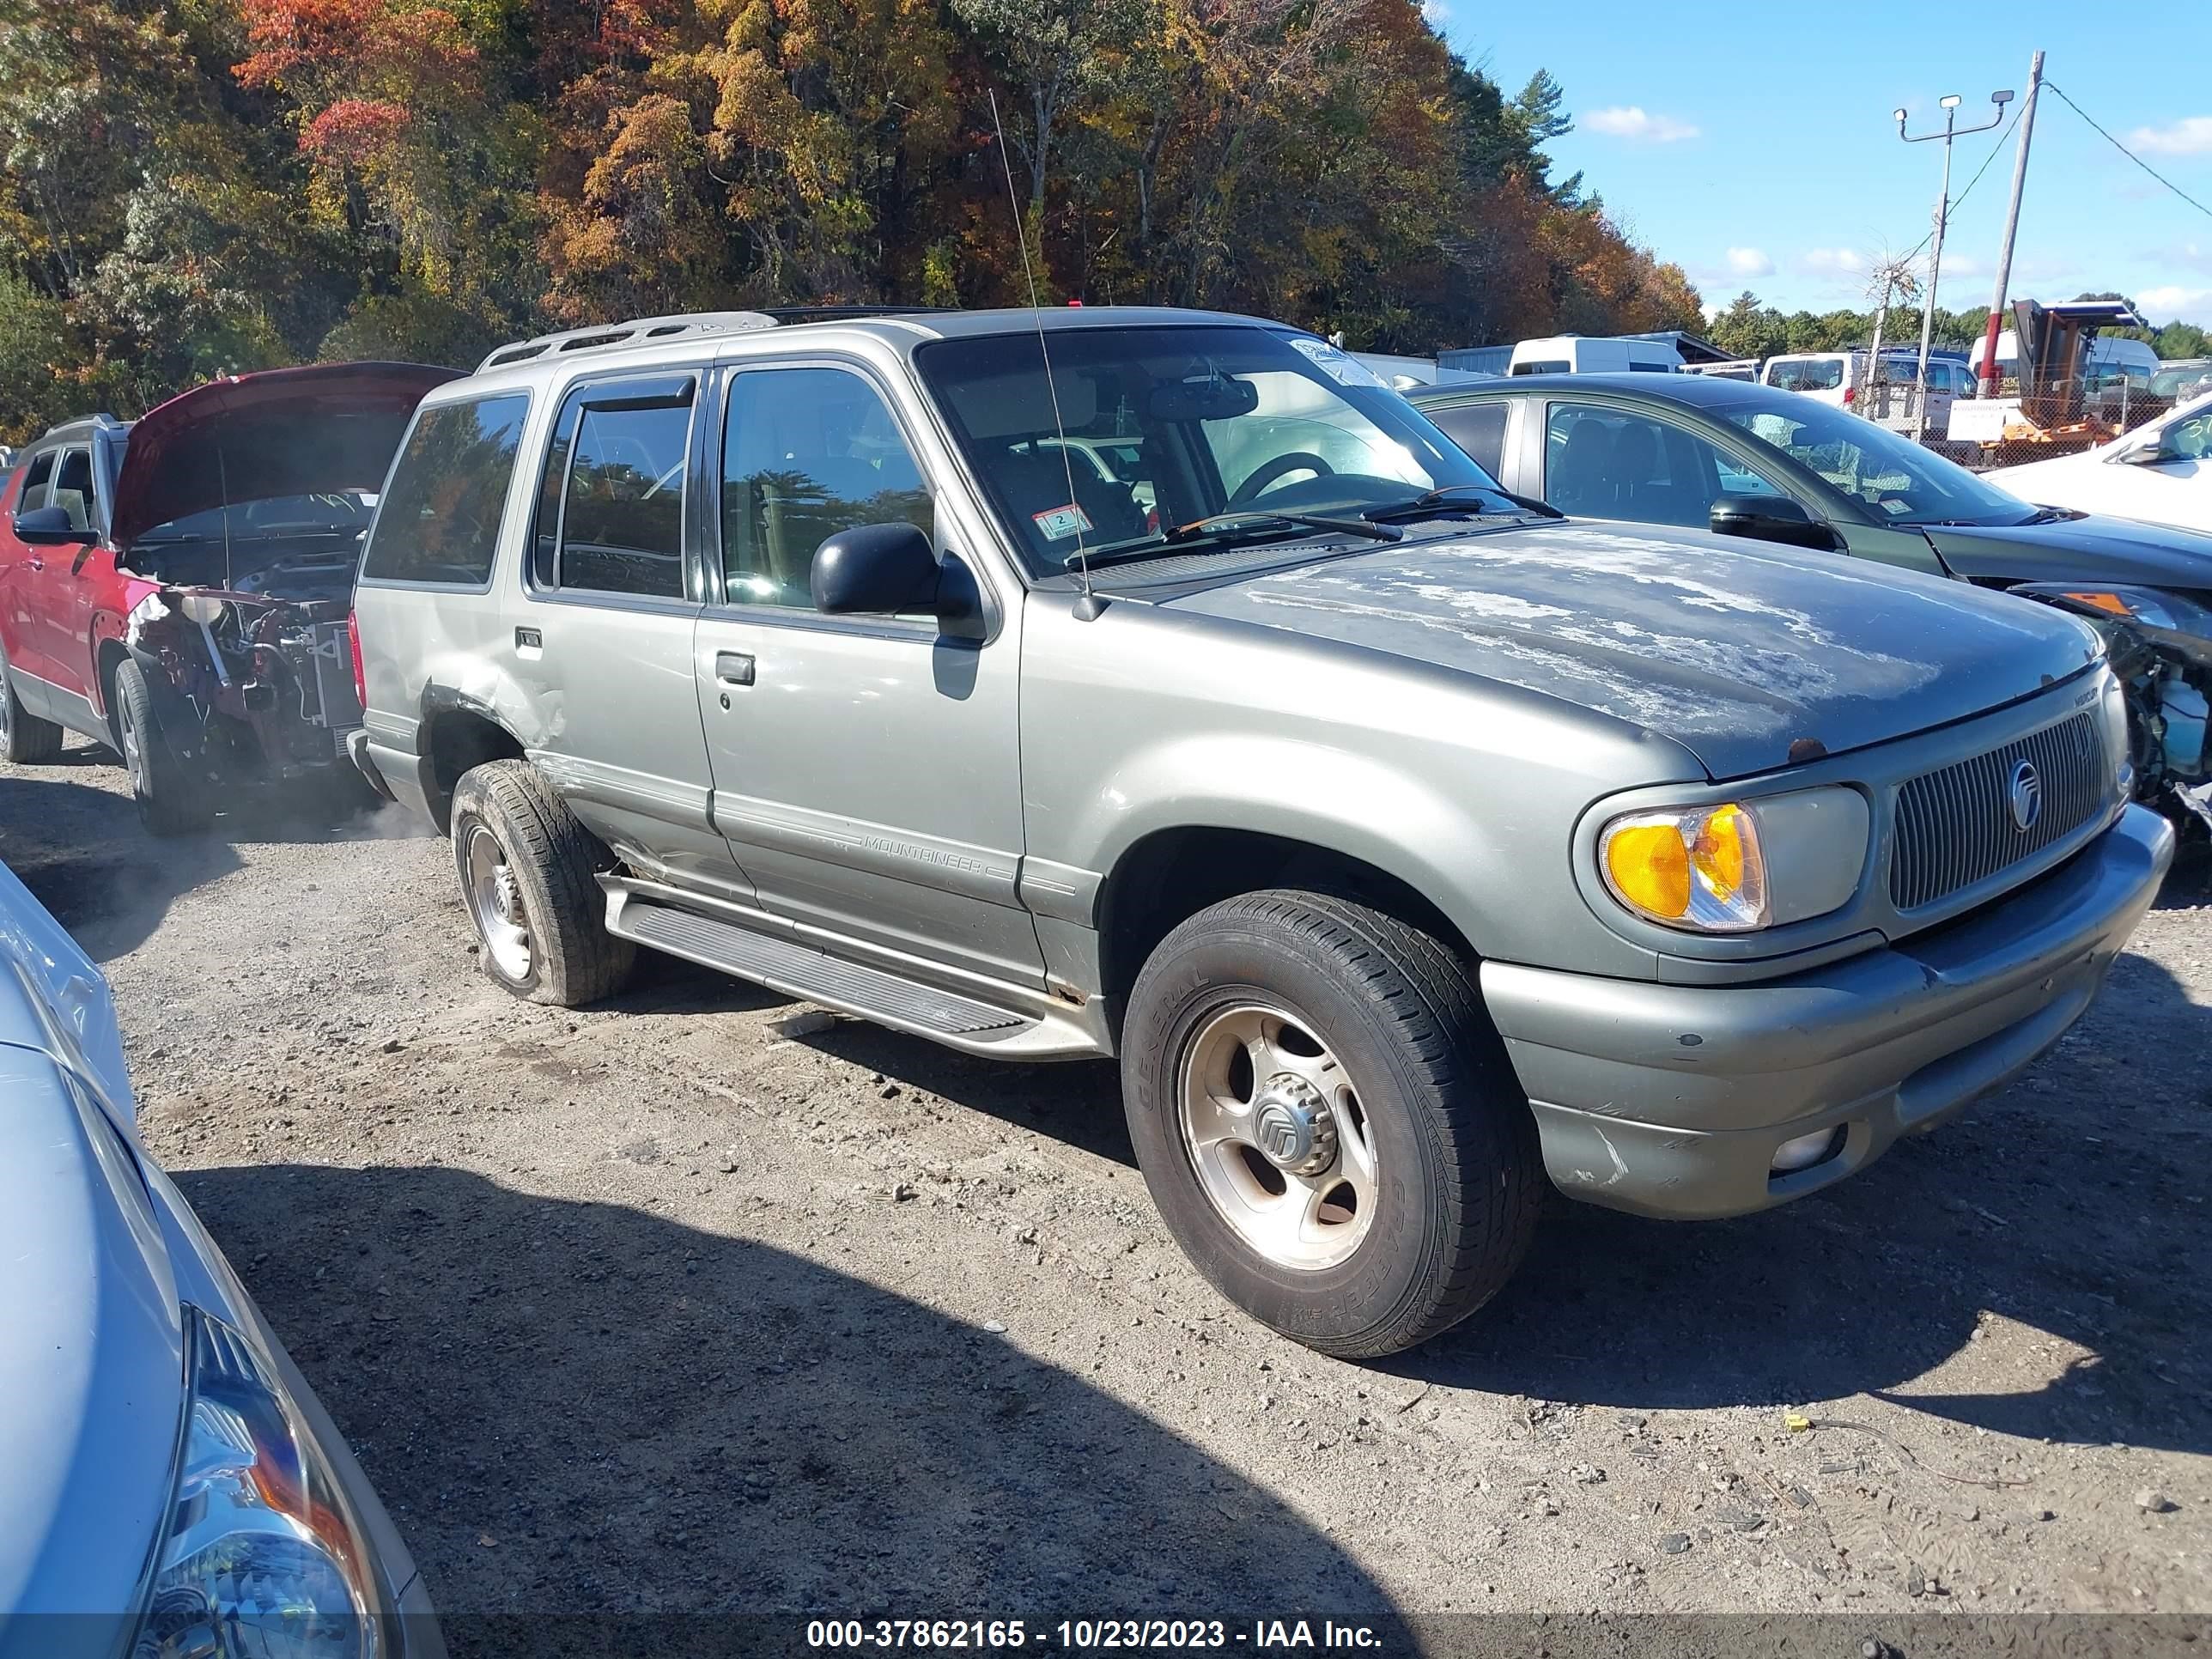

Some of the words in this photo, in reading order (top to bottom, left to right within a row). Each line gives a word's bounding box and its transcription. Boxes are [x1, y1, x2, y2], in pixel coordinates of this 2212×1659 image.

[1056, 515, 1066, 525] 2
[865, 836, 982, 873] MOUNTAINEER
[1139, 968, 1210, 1112] GENERAL
